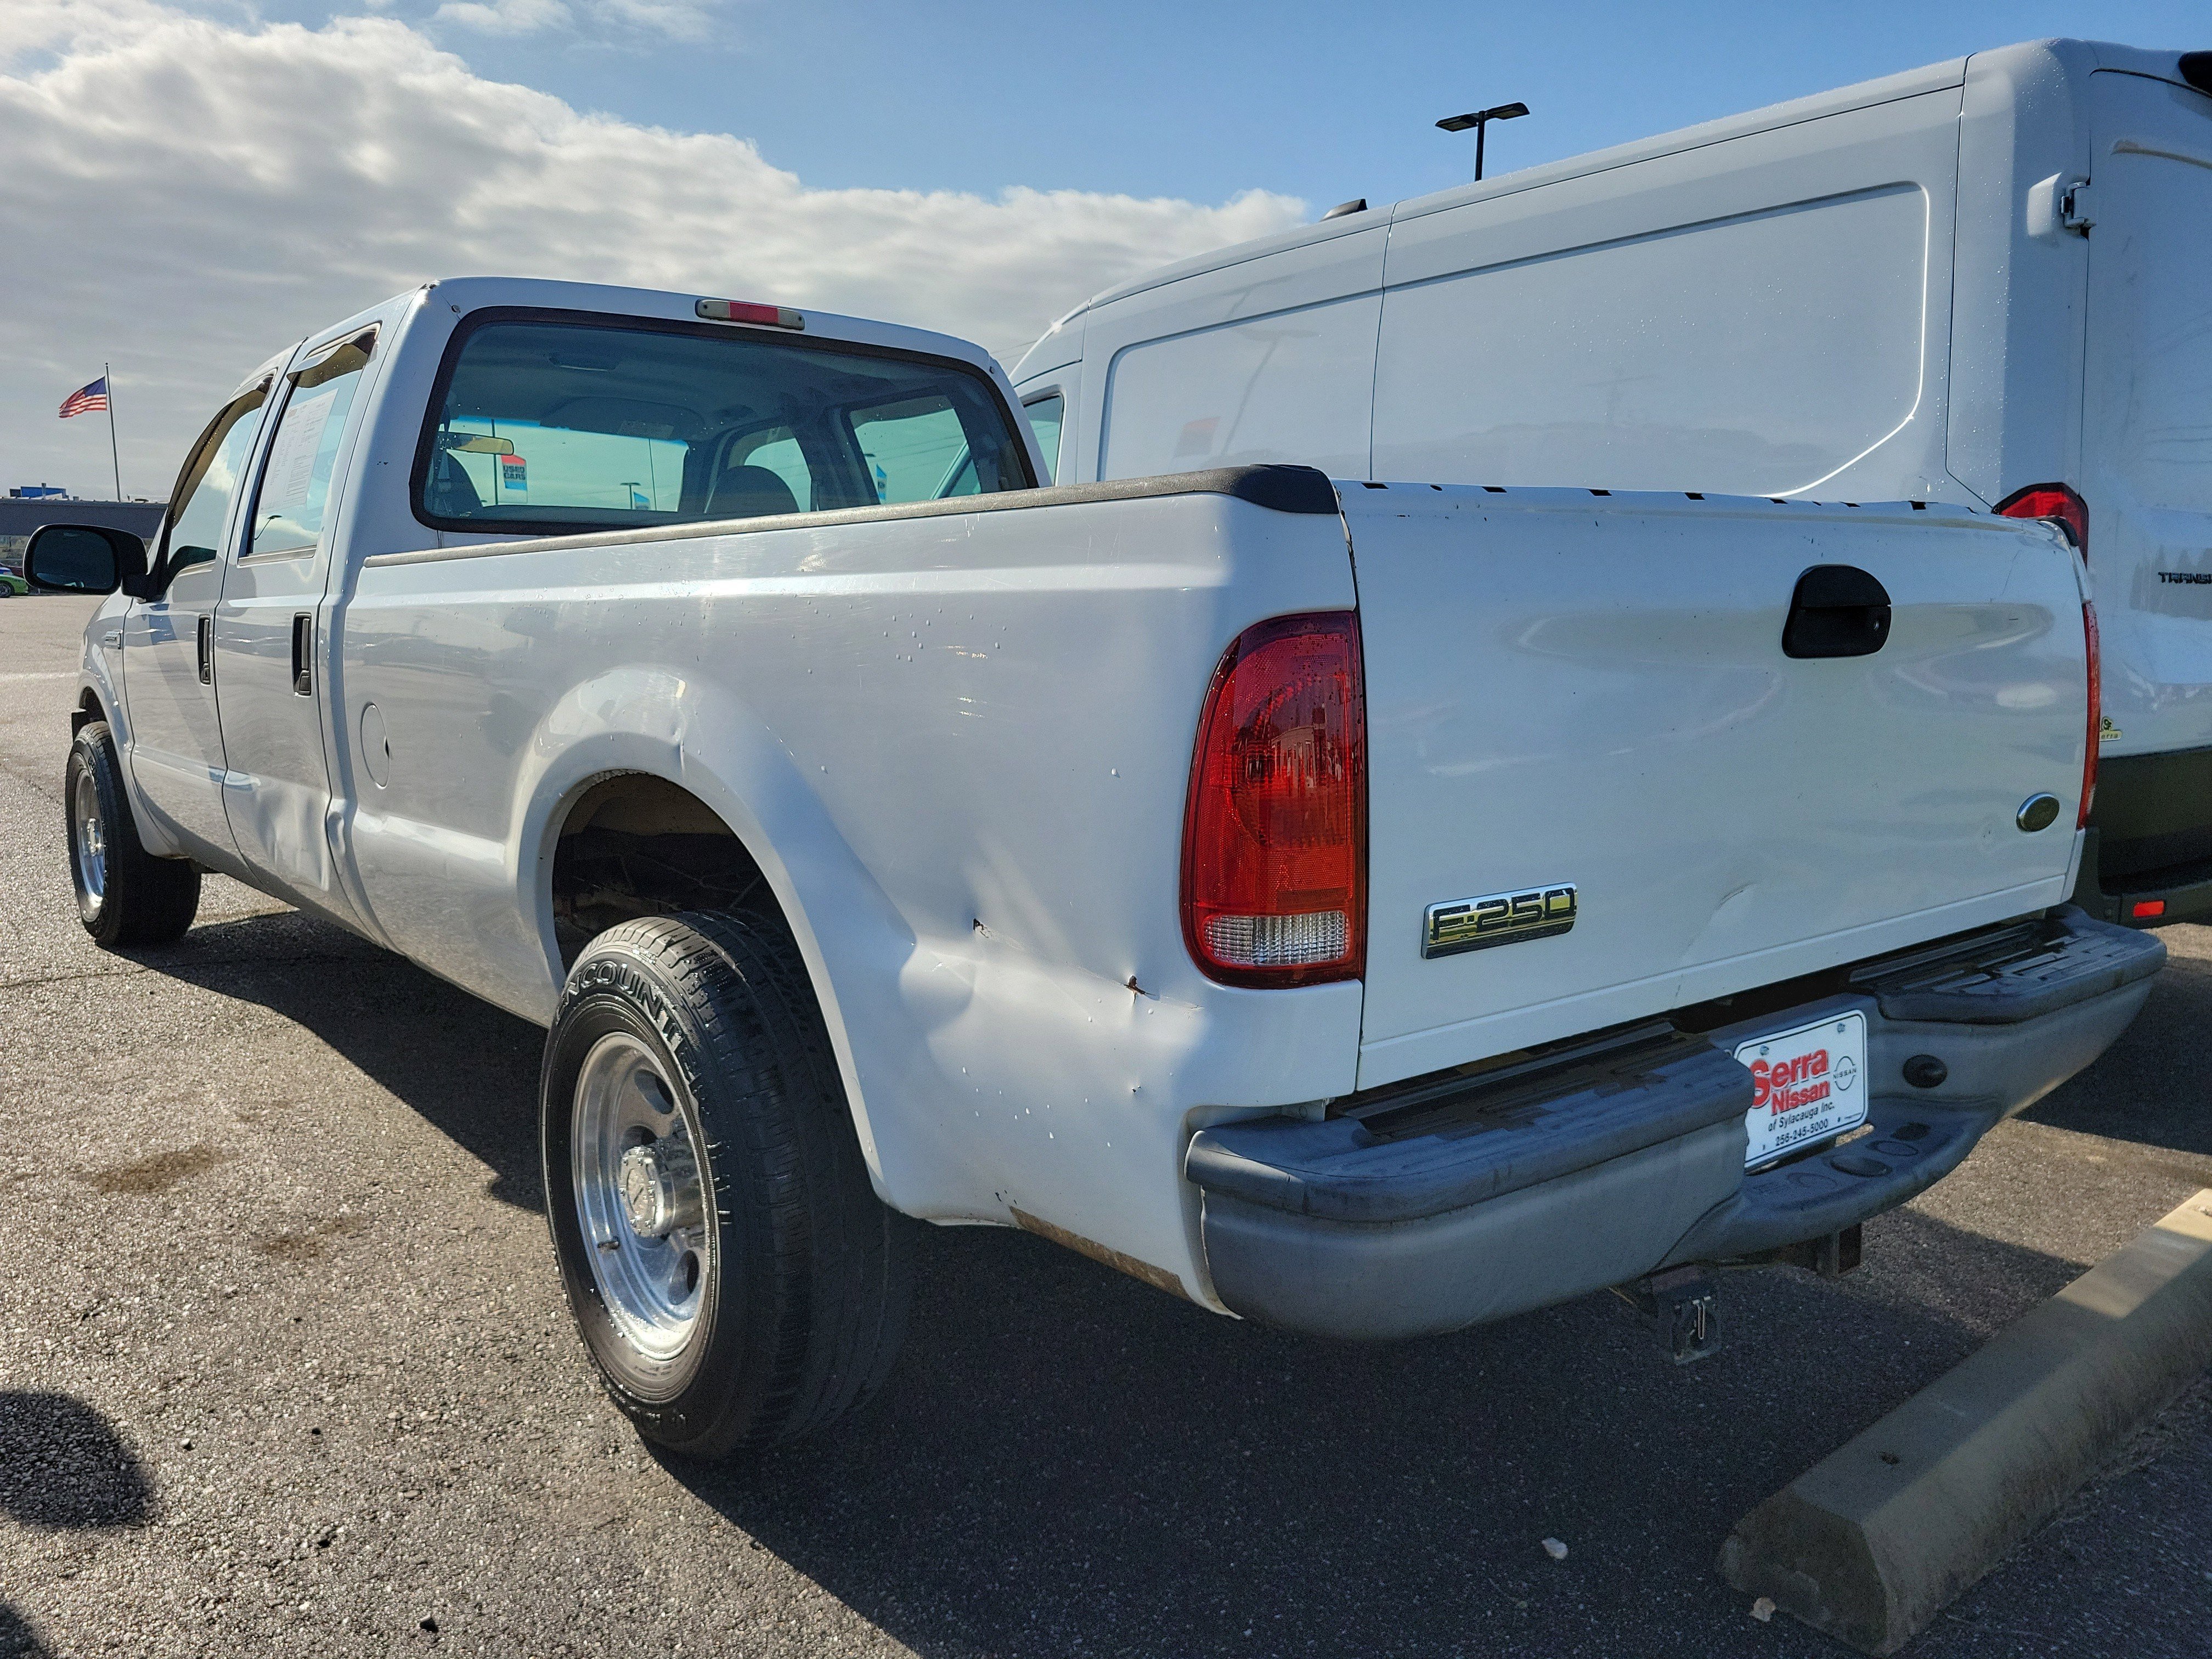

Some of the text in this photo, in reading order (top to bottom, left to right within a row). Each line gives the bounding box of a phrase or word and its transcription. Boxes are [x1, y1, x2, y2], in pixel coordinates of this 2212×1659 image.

[2158, 572, 2212, 584] TRANSI
[1432, 887, 1576, 940] F-250
[1748, 1048, 1830, 1109] Serra
[1833, 1068, 1857, 1079] NISSAN
[1771, 1080, 1831, 1116] Nissan
[1768, 1101, 1835, 1132] of Sylacauga Inc.
